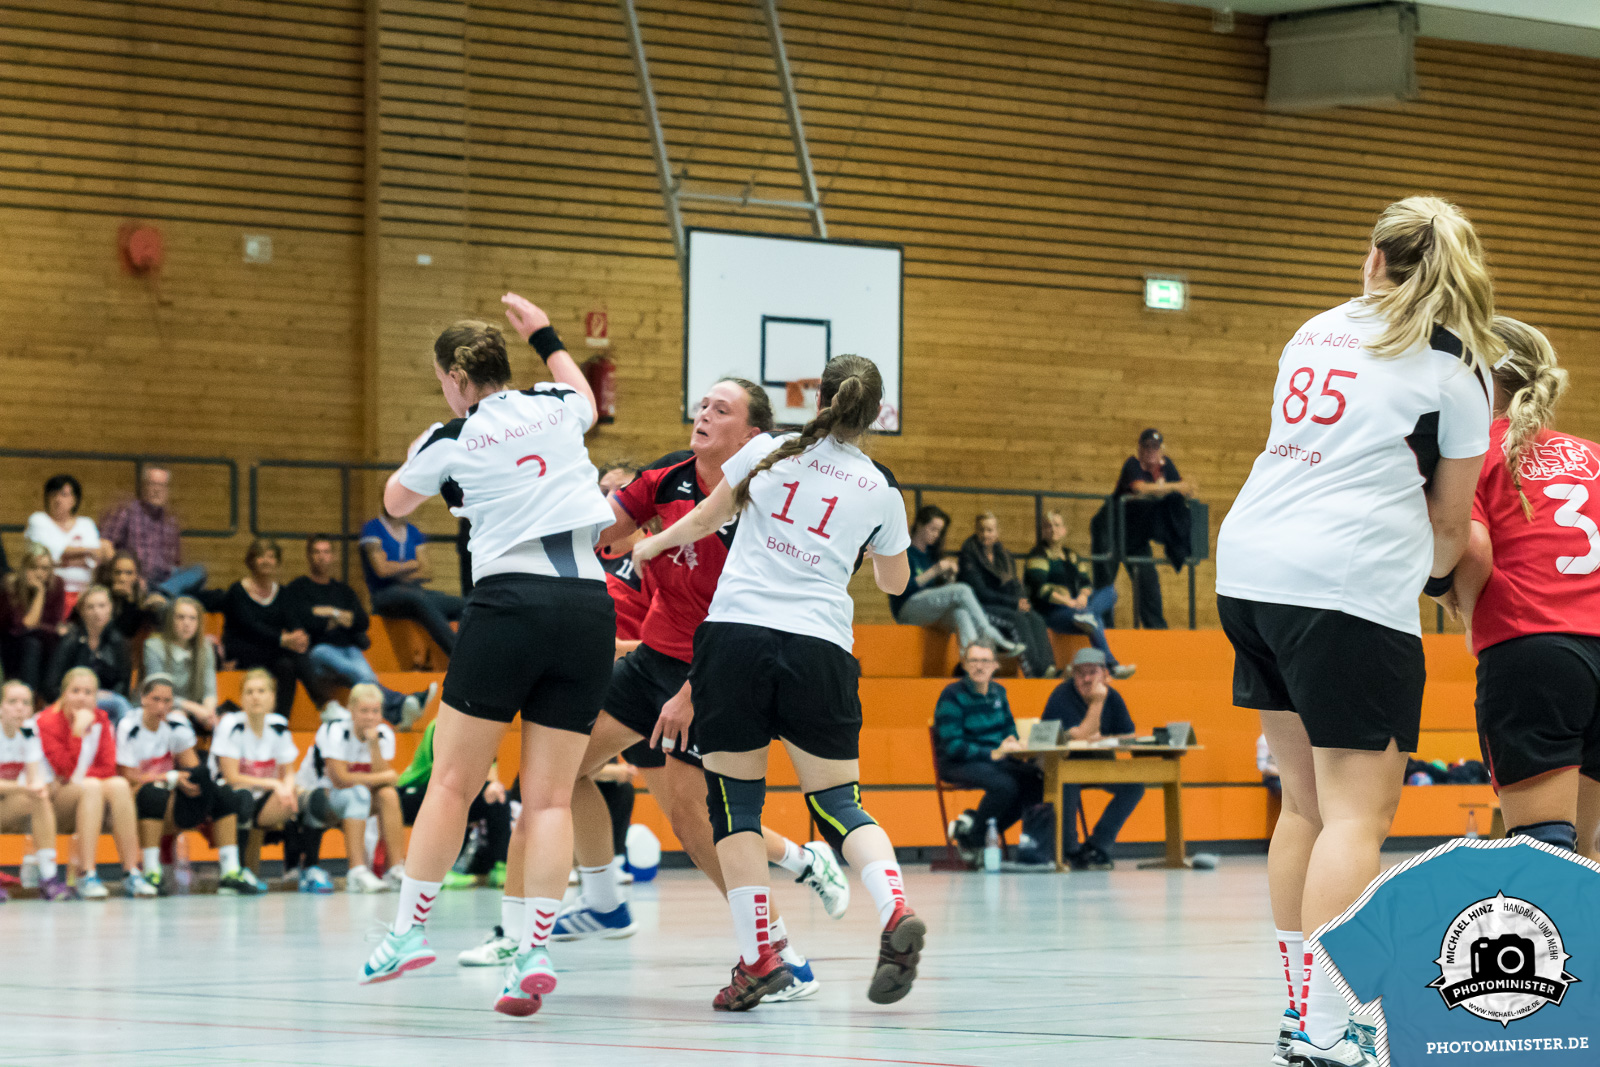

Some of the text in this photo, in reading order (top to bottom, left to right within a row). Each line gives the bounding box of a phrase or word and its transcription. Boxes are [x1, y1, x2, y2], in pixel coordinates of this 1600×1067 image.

[1320, 332, 1361, 349] Adle
[1282, 366, 1358, 425] 85
[466, 408, 565, 452] DJK Adler 07
[807, 459, 853, 482] Adler
[857, 476, 878, 492] 07
[771, 480, 839, 540] 11
[1542, 483, 1600, 575] 3
[615, 558, 635, 580] 11
[766, 535, 821, 567] Bottrop
